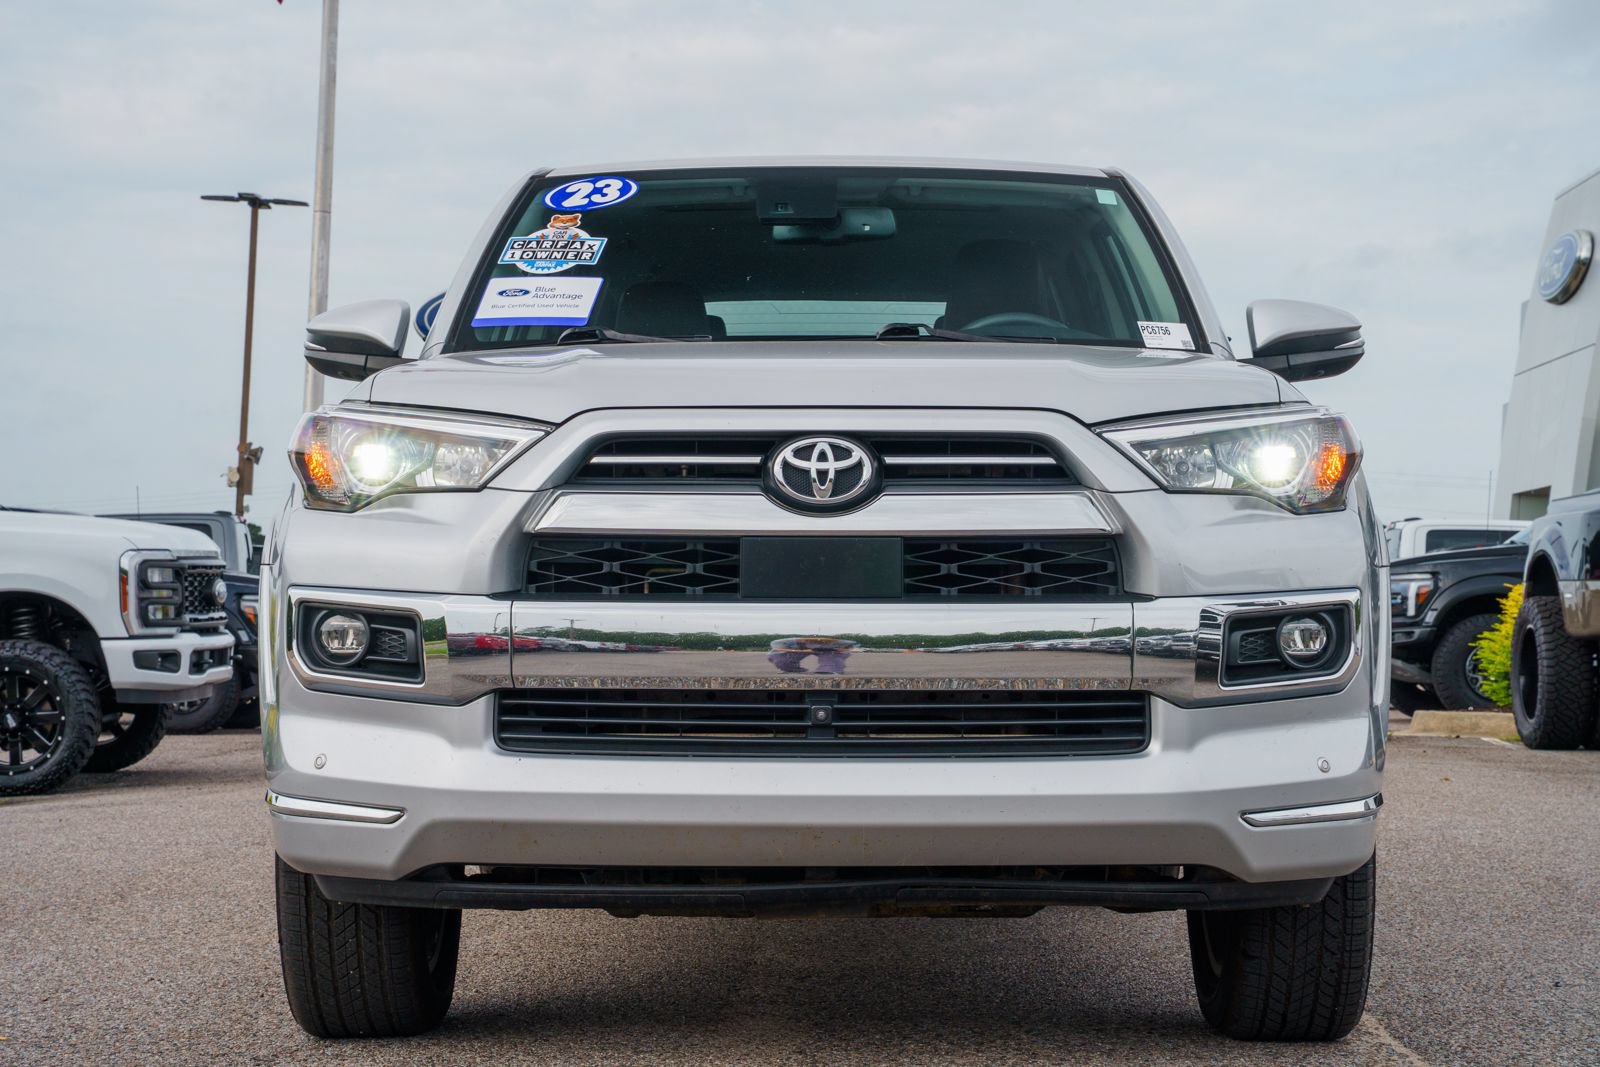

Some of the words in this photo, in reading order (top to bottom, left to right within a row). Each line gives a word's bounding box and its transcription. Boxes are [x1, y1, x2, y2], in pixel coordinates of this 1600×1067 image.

[561, 178, 623, 207] 23
[512, 240, 597, 250] CARFAX
[508, 251, 516, 259] 1
[522, 251, 592, 260] OWNER
[532, 292, 583, 300] Advantage
[1140, 325, 1171, 335] PC6756
